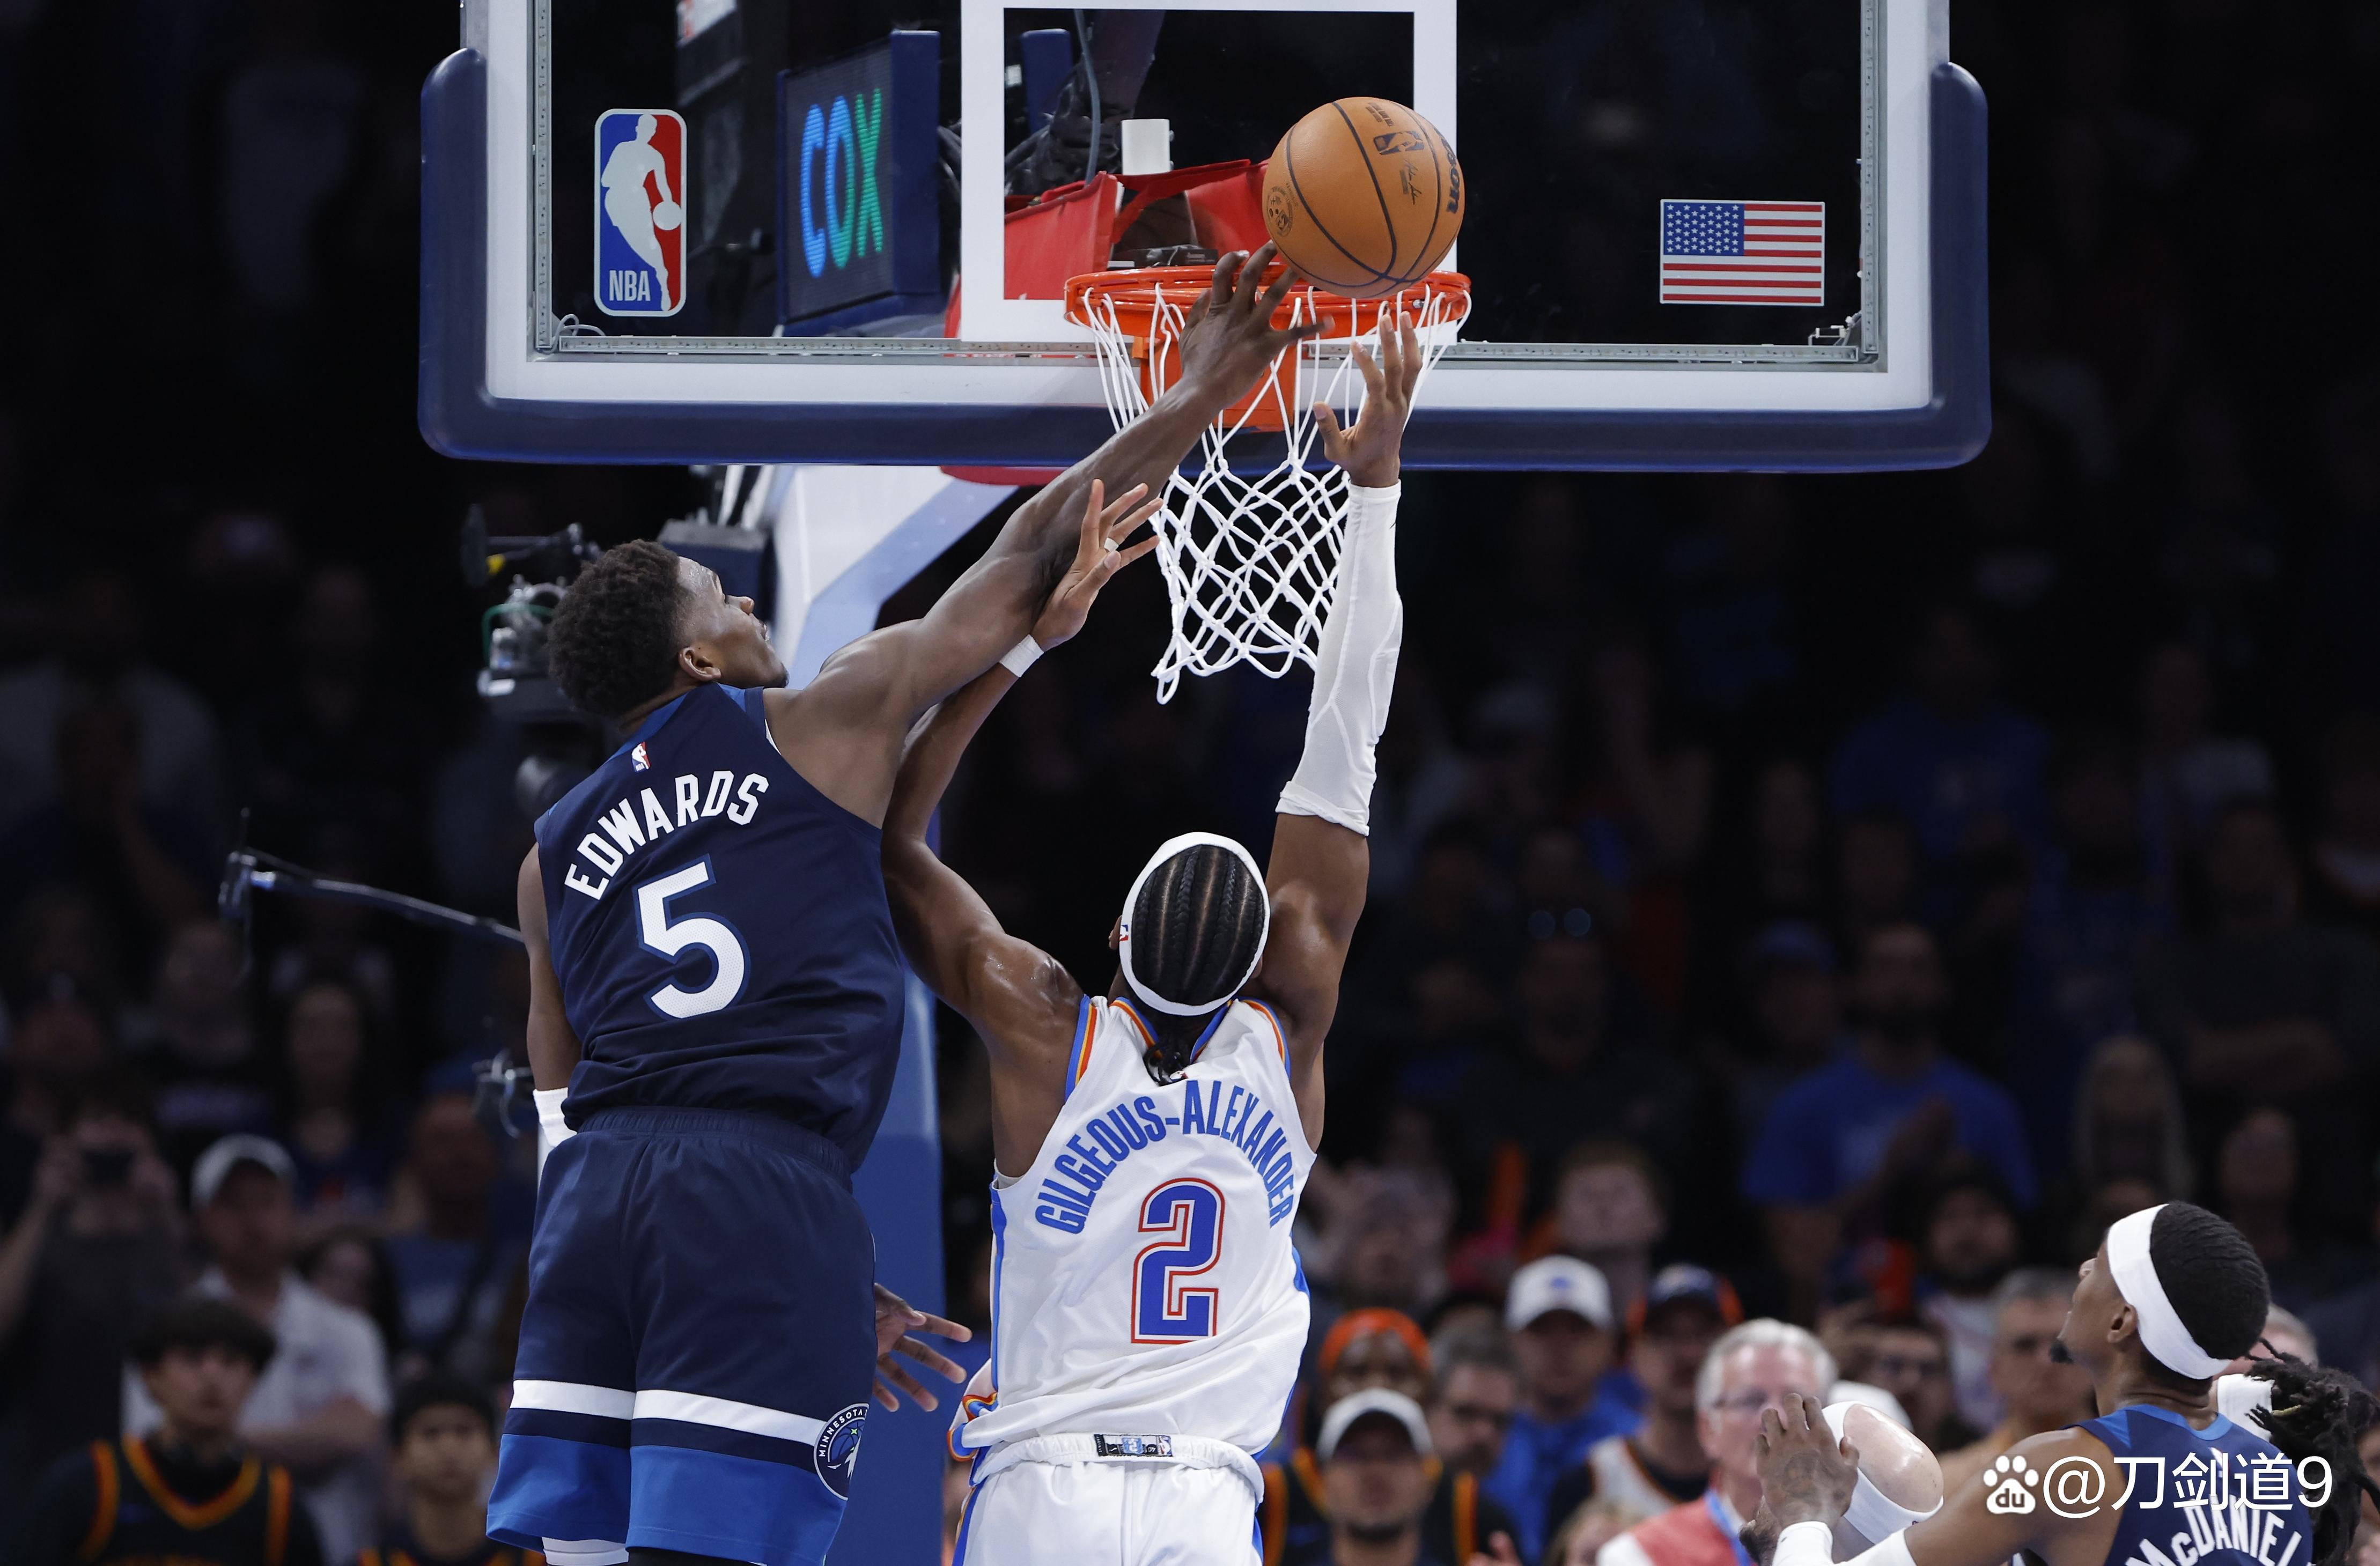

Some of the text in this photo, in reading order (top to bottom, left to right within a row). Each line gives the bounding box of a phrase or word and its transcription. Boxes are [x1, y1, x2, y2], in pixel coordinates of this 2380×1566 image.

[799, 88, 882, 278] COX
[608, 270, 651, 302] NBA
[564, 770, 769, 900] EDWARDS
[635, 763, 645, 772] NBA
[632, 853, 751, 1020] 5
[1035, 1080, 1296, 1235] GILGEOUS-ALEXANDER
[1131, 1177, 1226, 1345] 2
[819, 1408, 863, 1457] MINNESOTA
